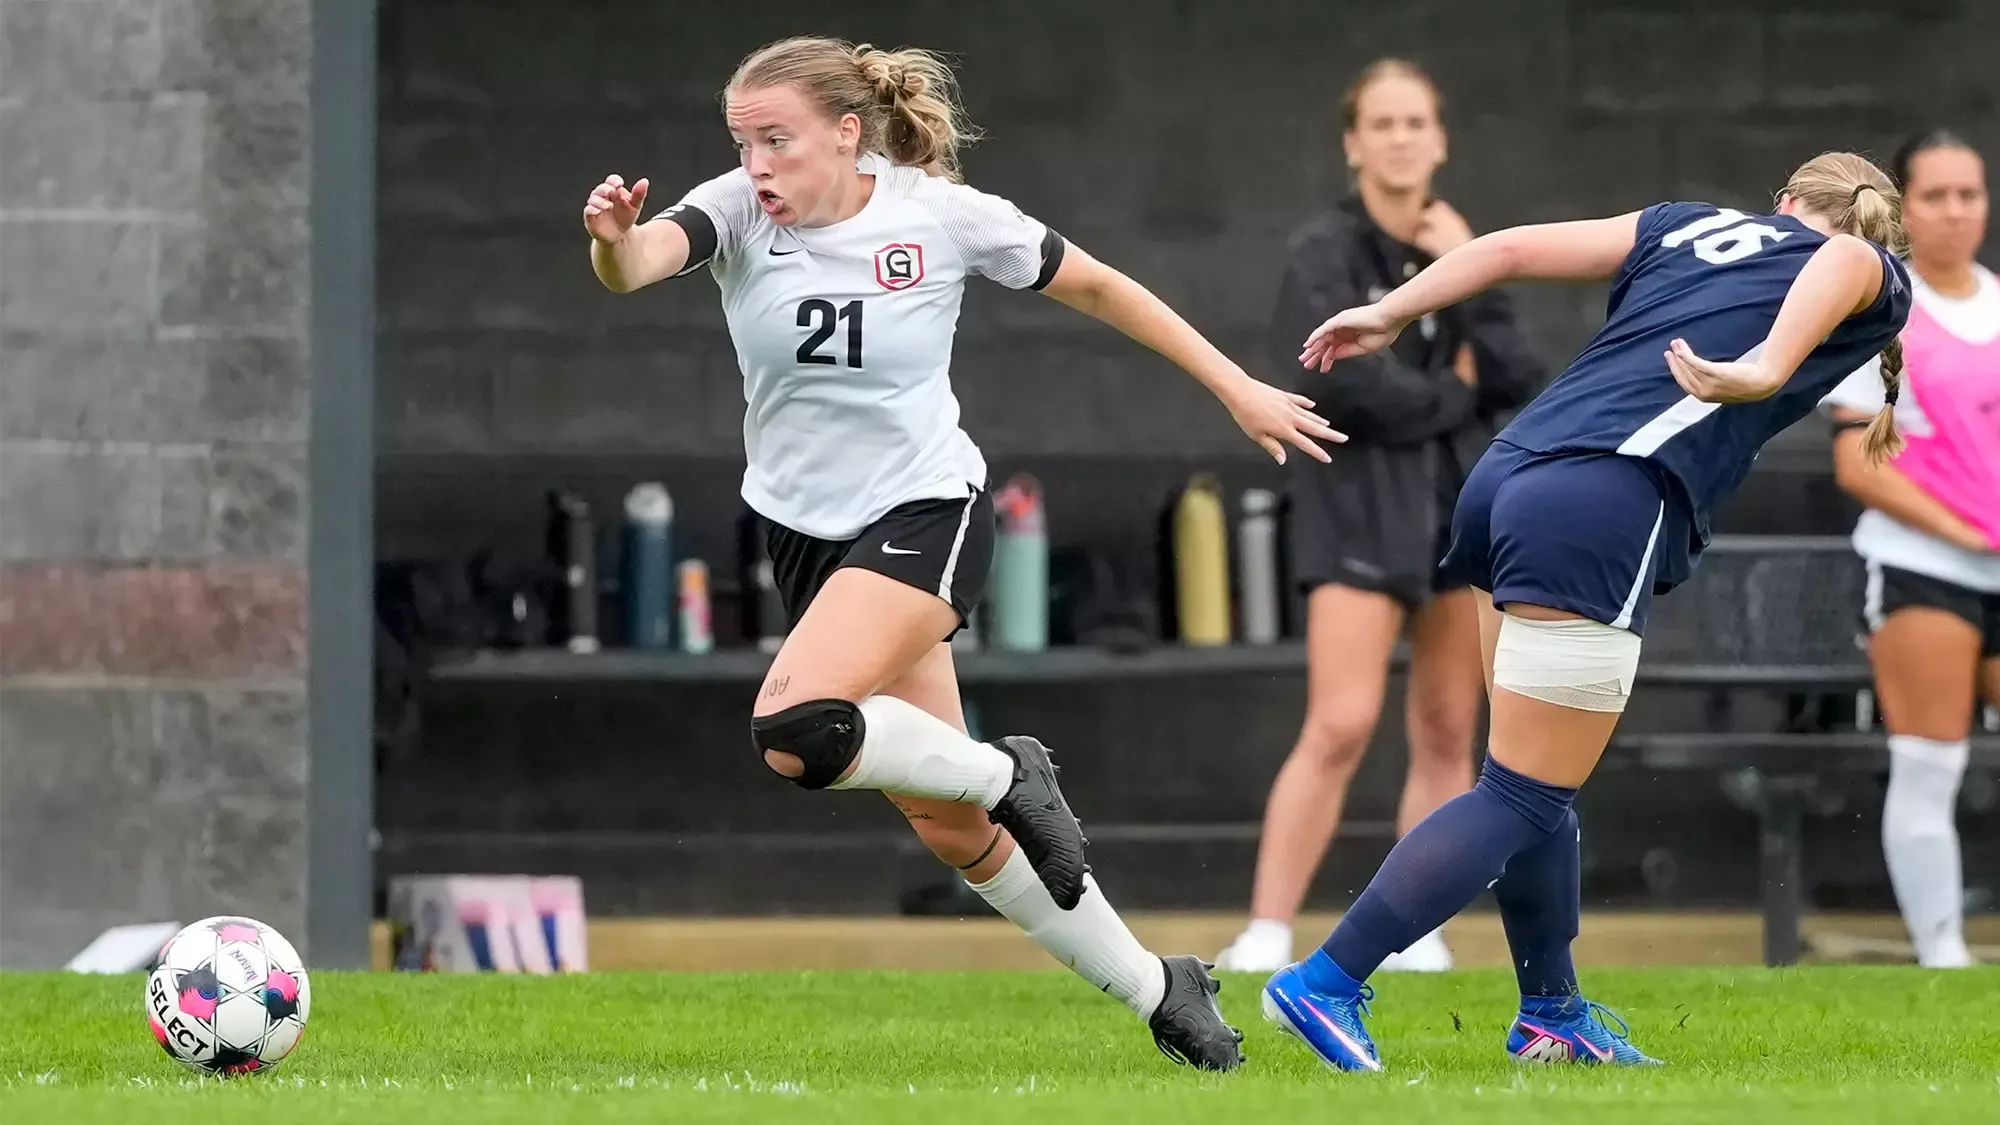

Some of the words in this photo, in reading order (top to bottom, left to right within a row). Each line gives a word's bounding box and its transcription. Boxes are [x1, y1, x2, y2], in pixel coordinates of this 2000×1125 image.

[886, 248, 912, 279] G
[1661, 208, 1794, 265] 16
[796, 299, 864, 368] 21
[150, 976, 210, 1057] SELECT
